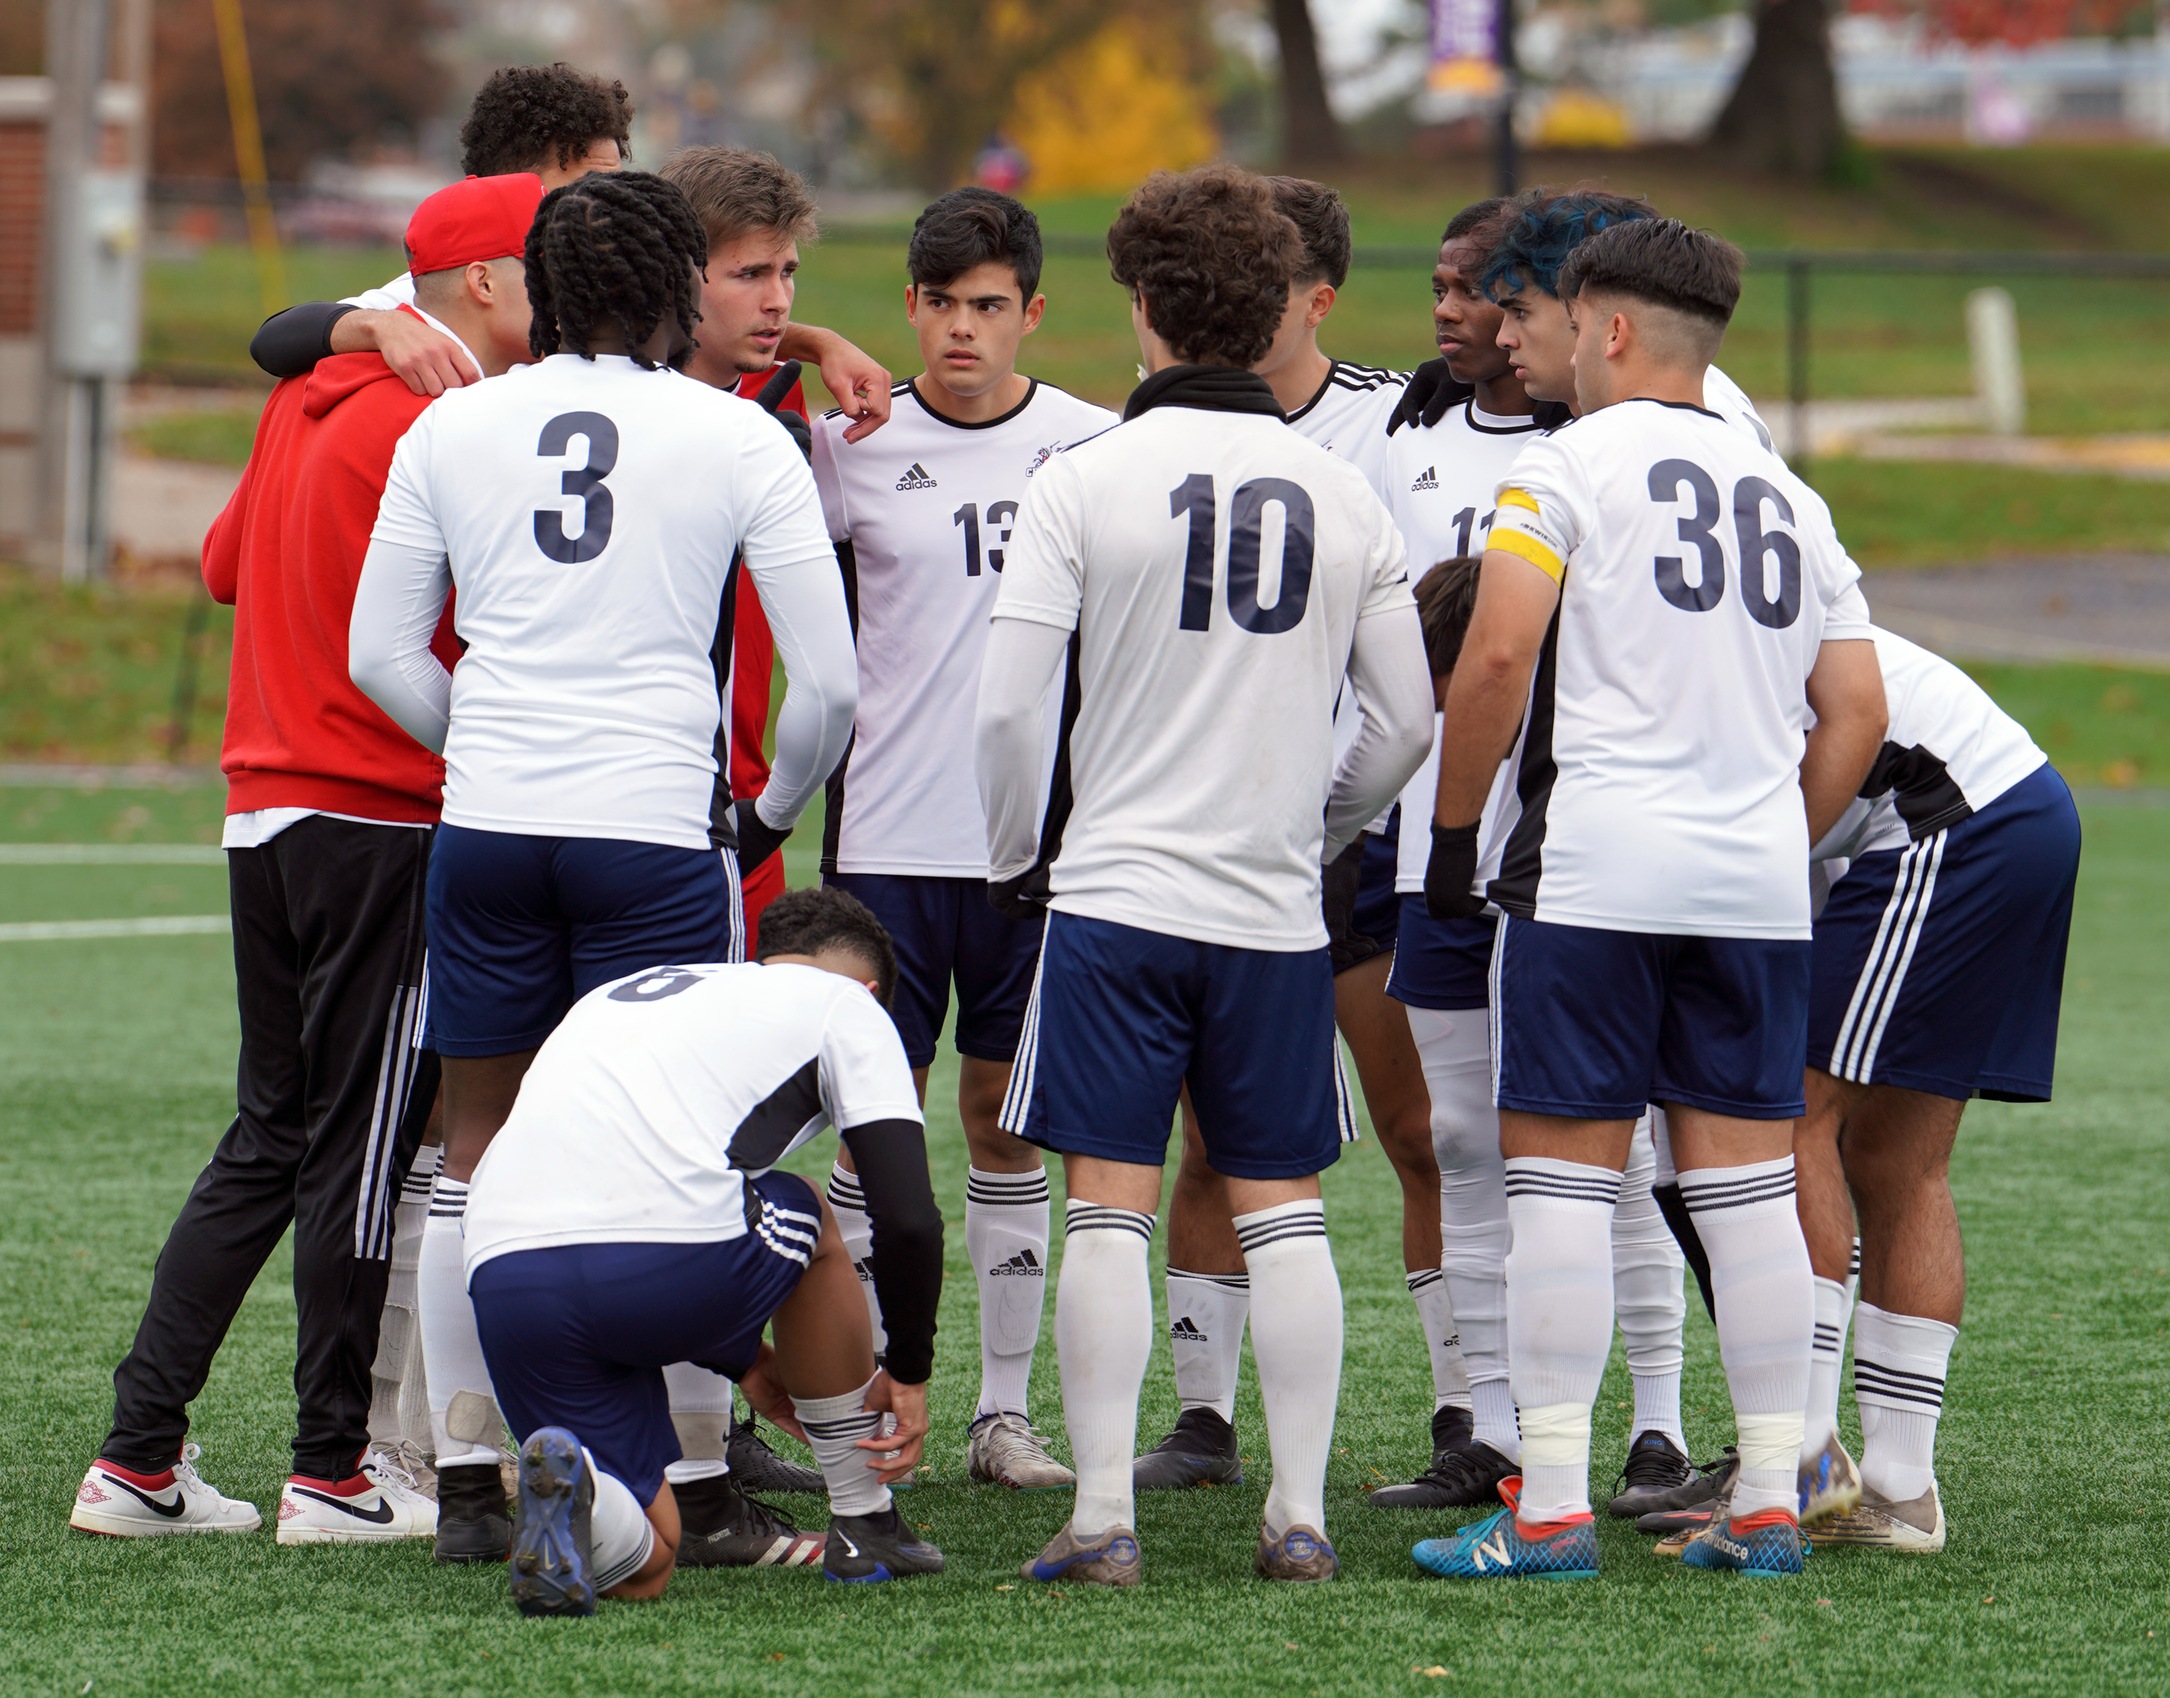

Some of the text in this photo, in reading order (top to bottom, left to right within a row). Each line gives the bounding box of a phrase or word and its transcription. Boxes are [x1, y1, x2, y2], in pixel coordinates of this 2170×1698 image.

[533, 411, 619, 564] 3
[895, 478, 938, 492] adidas
[1411, 480, 1440, 492] adidas
[953, 500, 1020, 577] 13
[1170, 473, 1315, 635] 10
[1647, 458, 1803, 630] 36
[989, 1266, 1044, 1277] adidas
